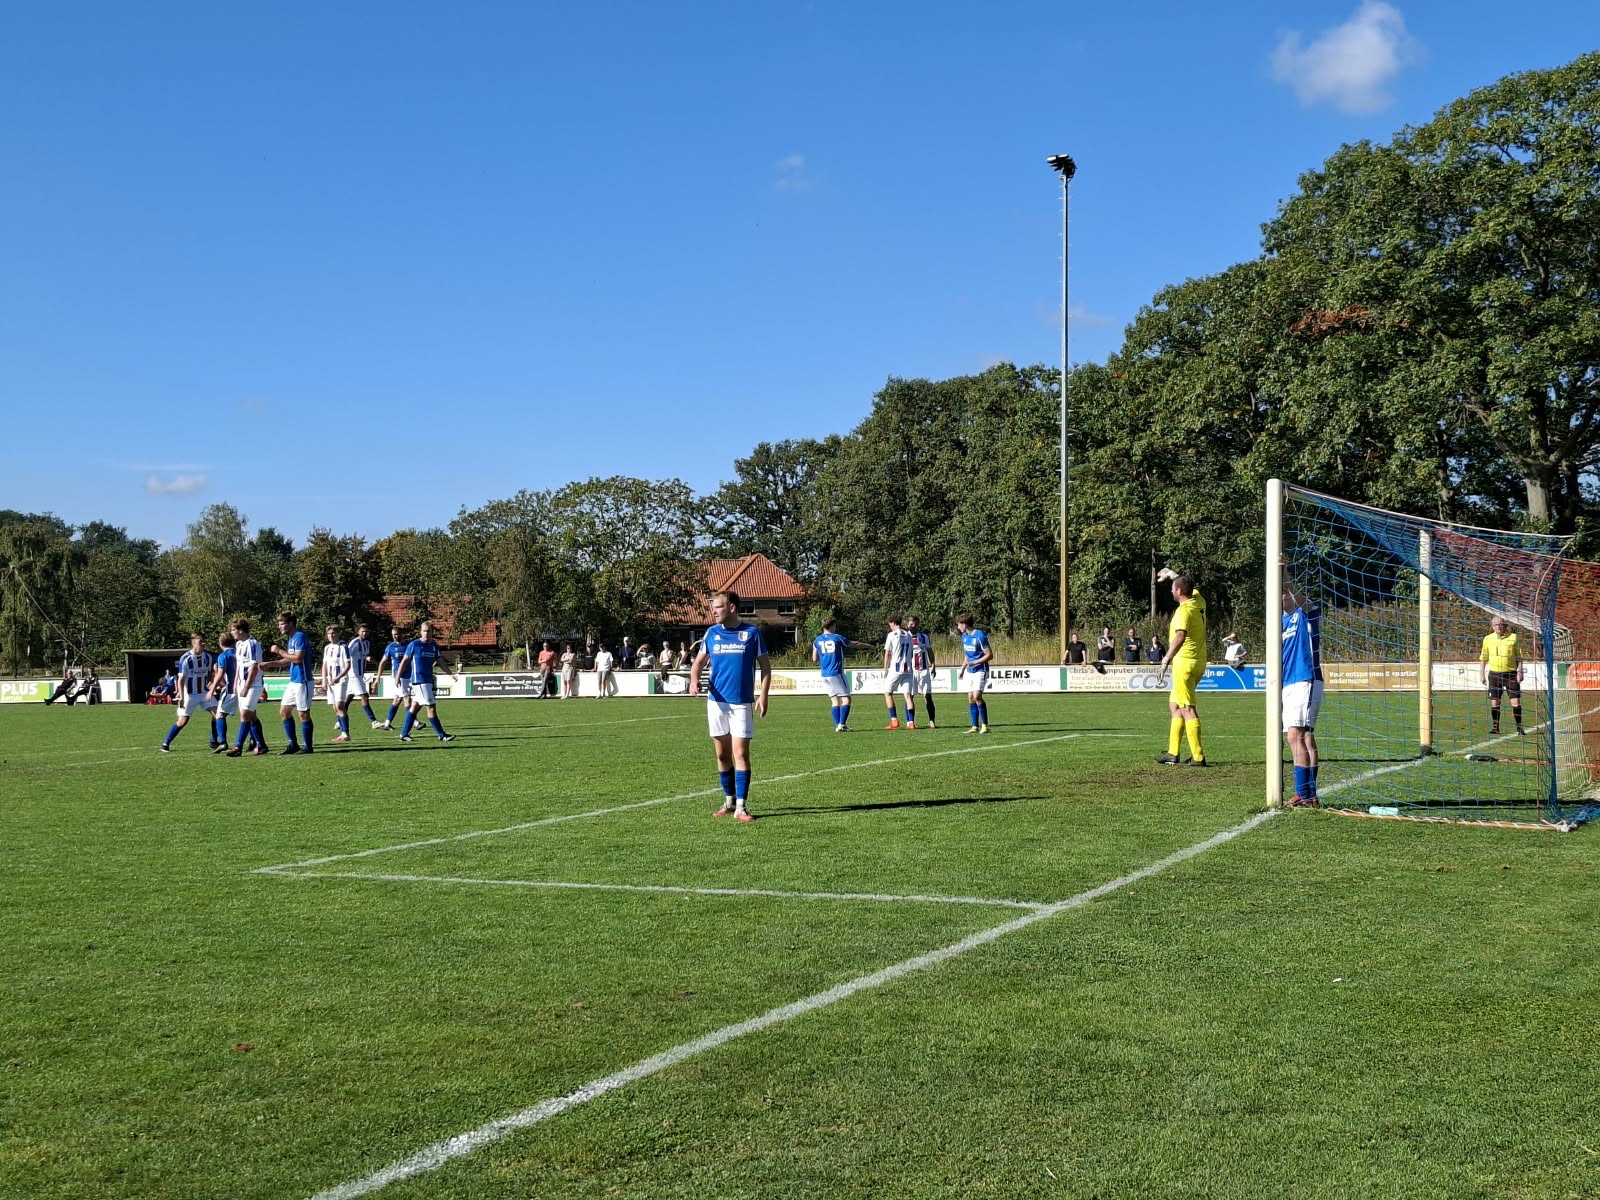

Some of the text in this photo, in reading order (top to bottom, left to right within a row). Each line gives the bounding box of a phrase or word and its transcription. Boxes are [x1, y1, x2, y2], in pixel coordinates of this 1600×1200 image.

[818, 640, 836, 654] 19
[990, 669, 1031, 679] LLEMS
[1, 683, 38, 695] PLUS
